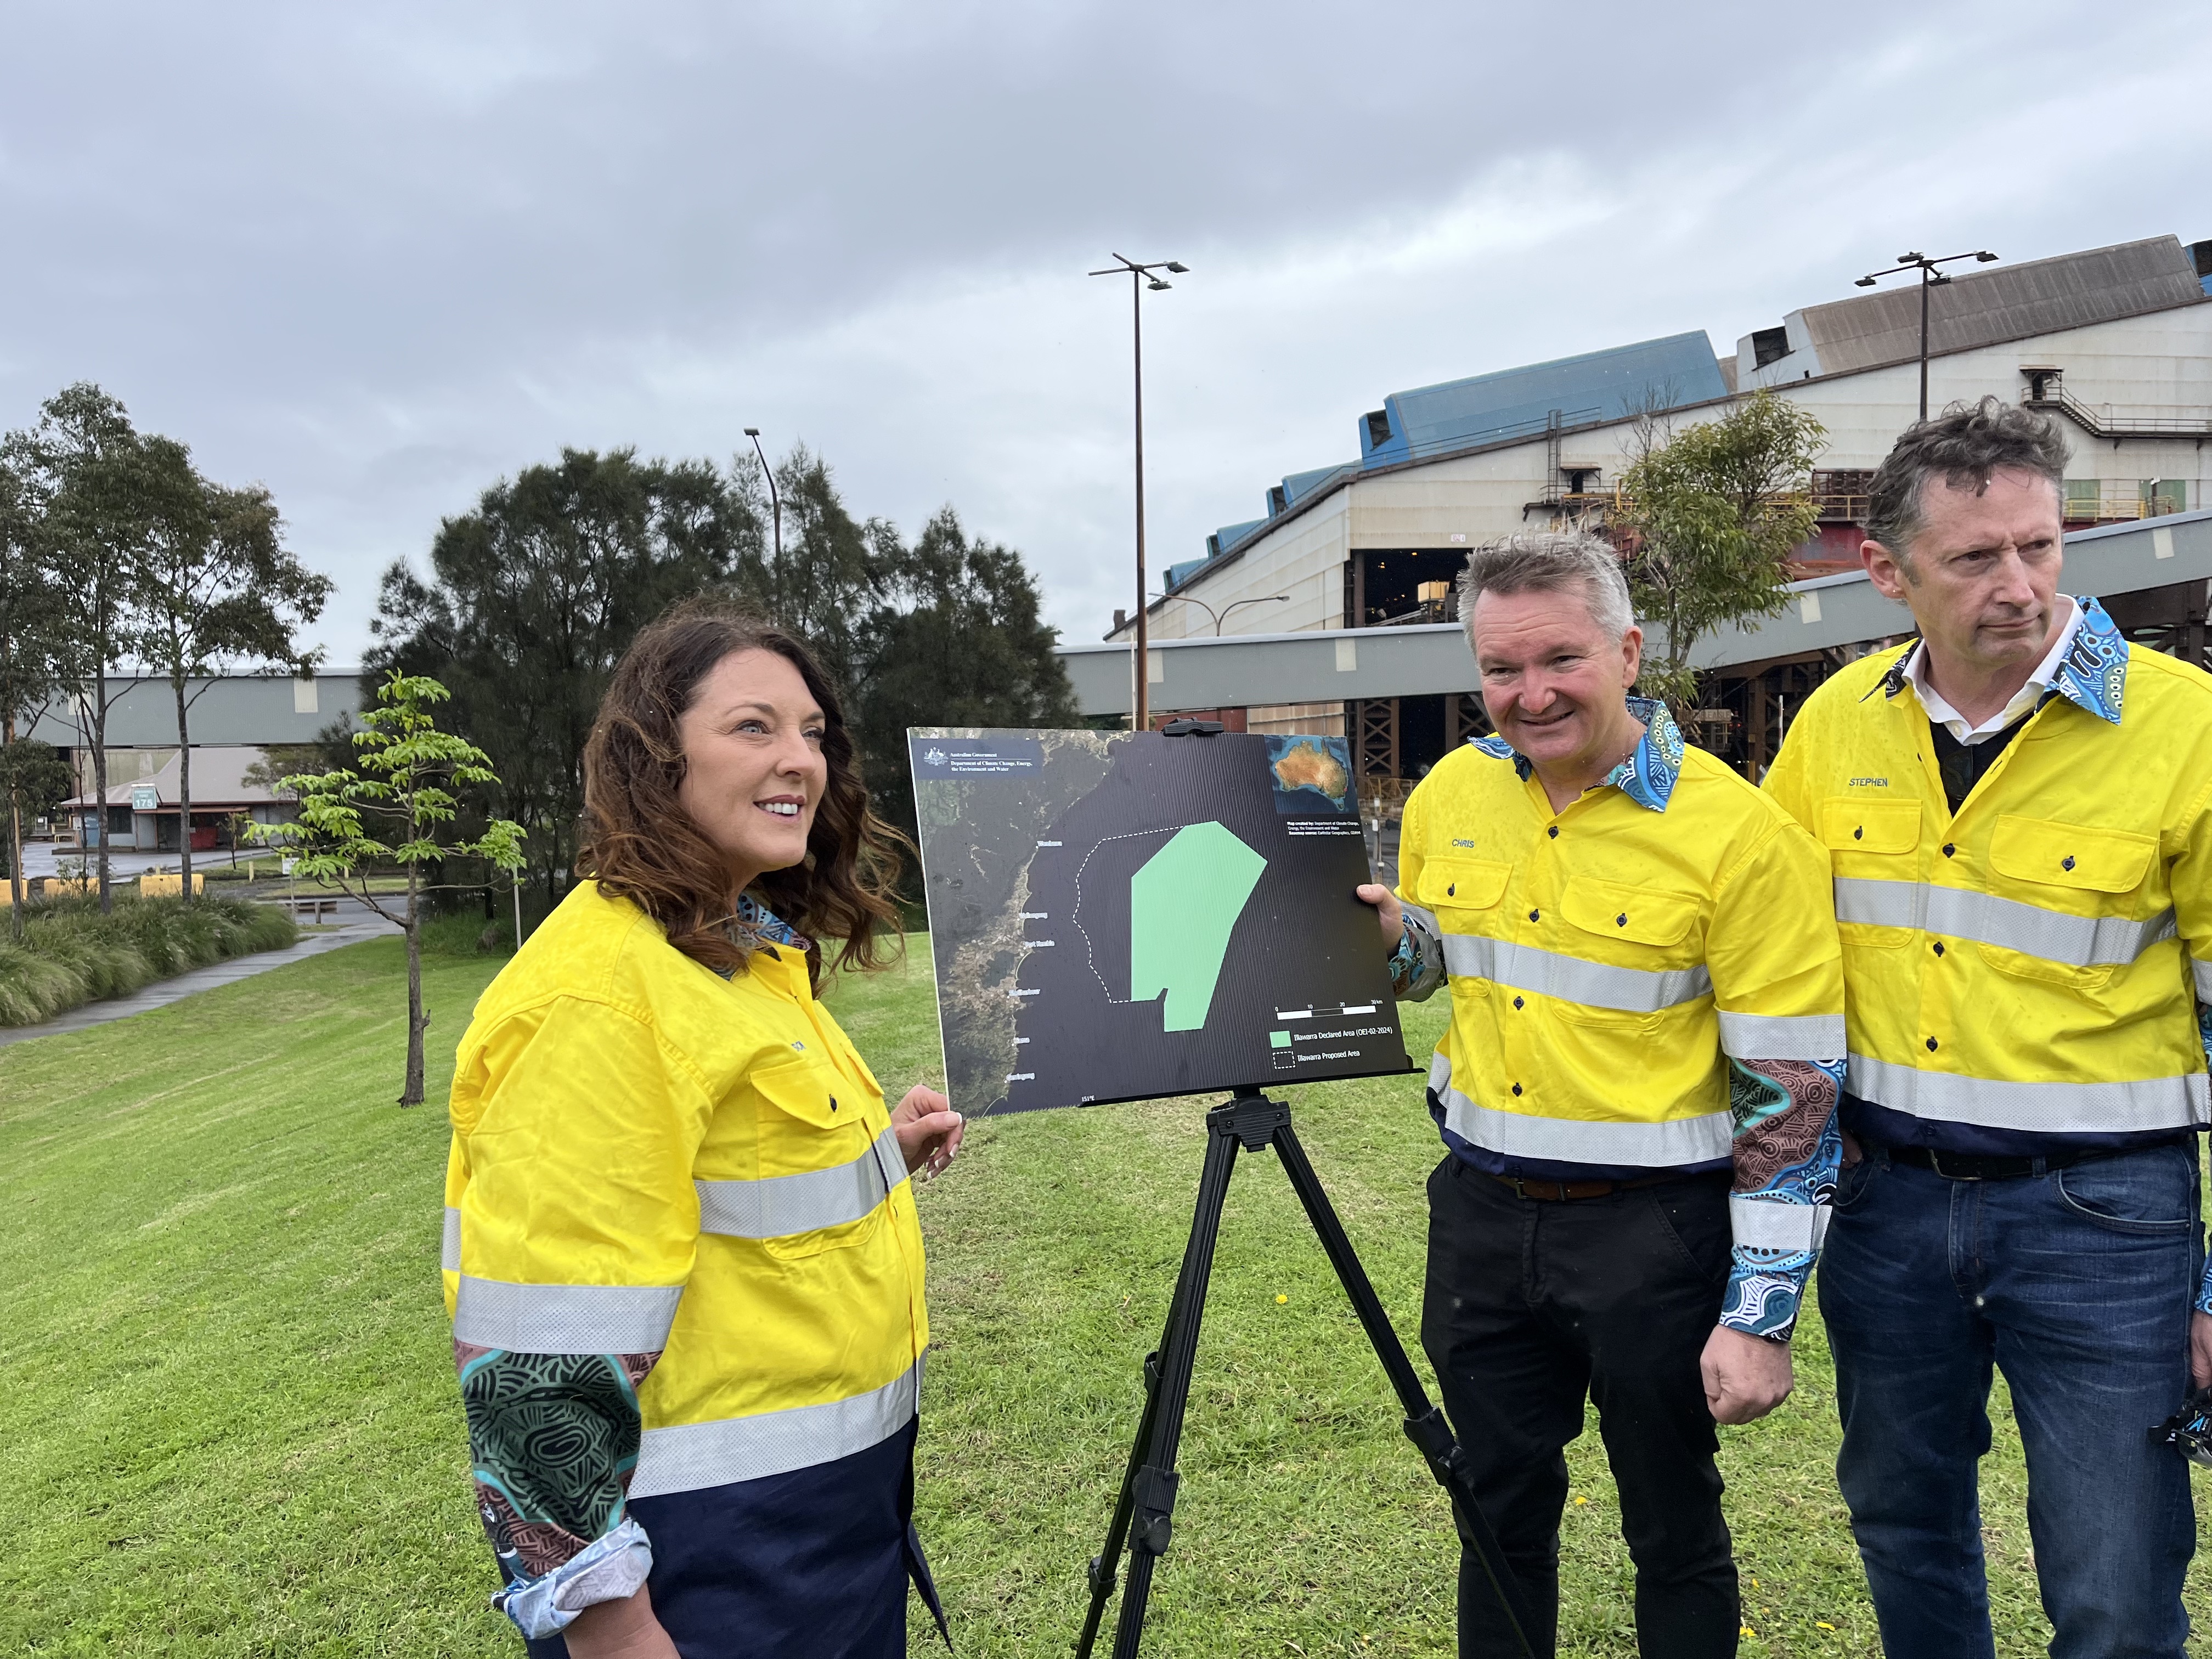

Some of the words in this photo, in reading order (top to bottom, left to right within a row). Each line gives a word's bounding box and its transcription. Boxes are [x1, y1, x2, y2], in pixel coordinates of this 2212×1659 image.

[1849, 777, 1888, 787] STEPHEN
[1452, 839, 1475, 848] CHRIS
[1318, 1031, 1342, 1039] Declared
[1356, 1026, 1393, 1037] (OEI-02-2024)
[1322, 1051, 1347, 1060] Proposed
